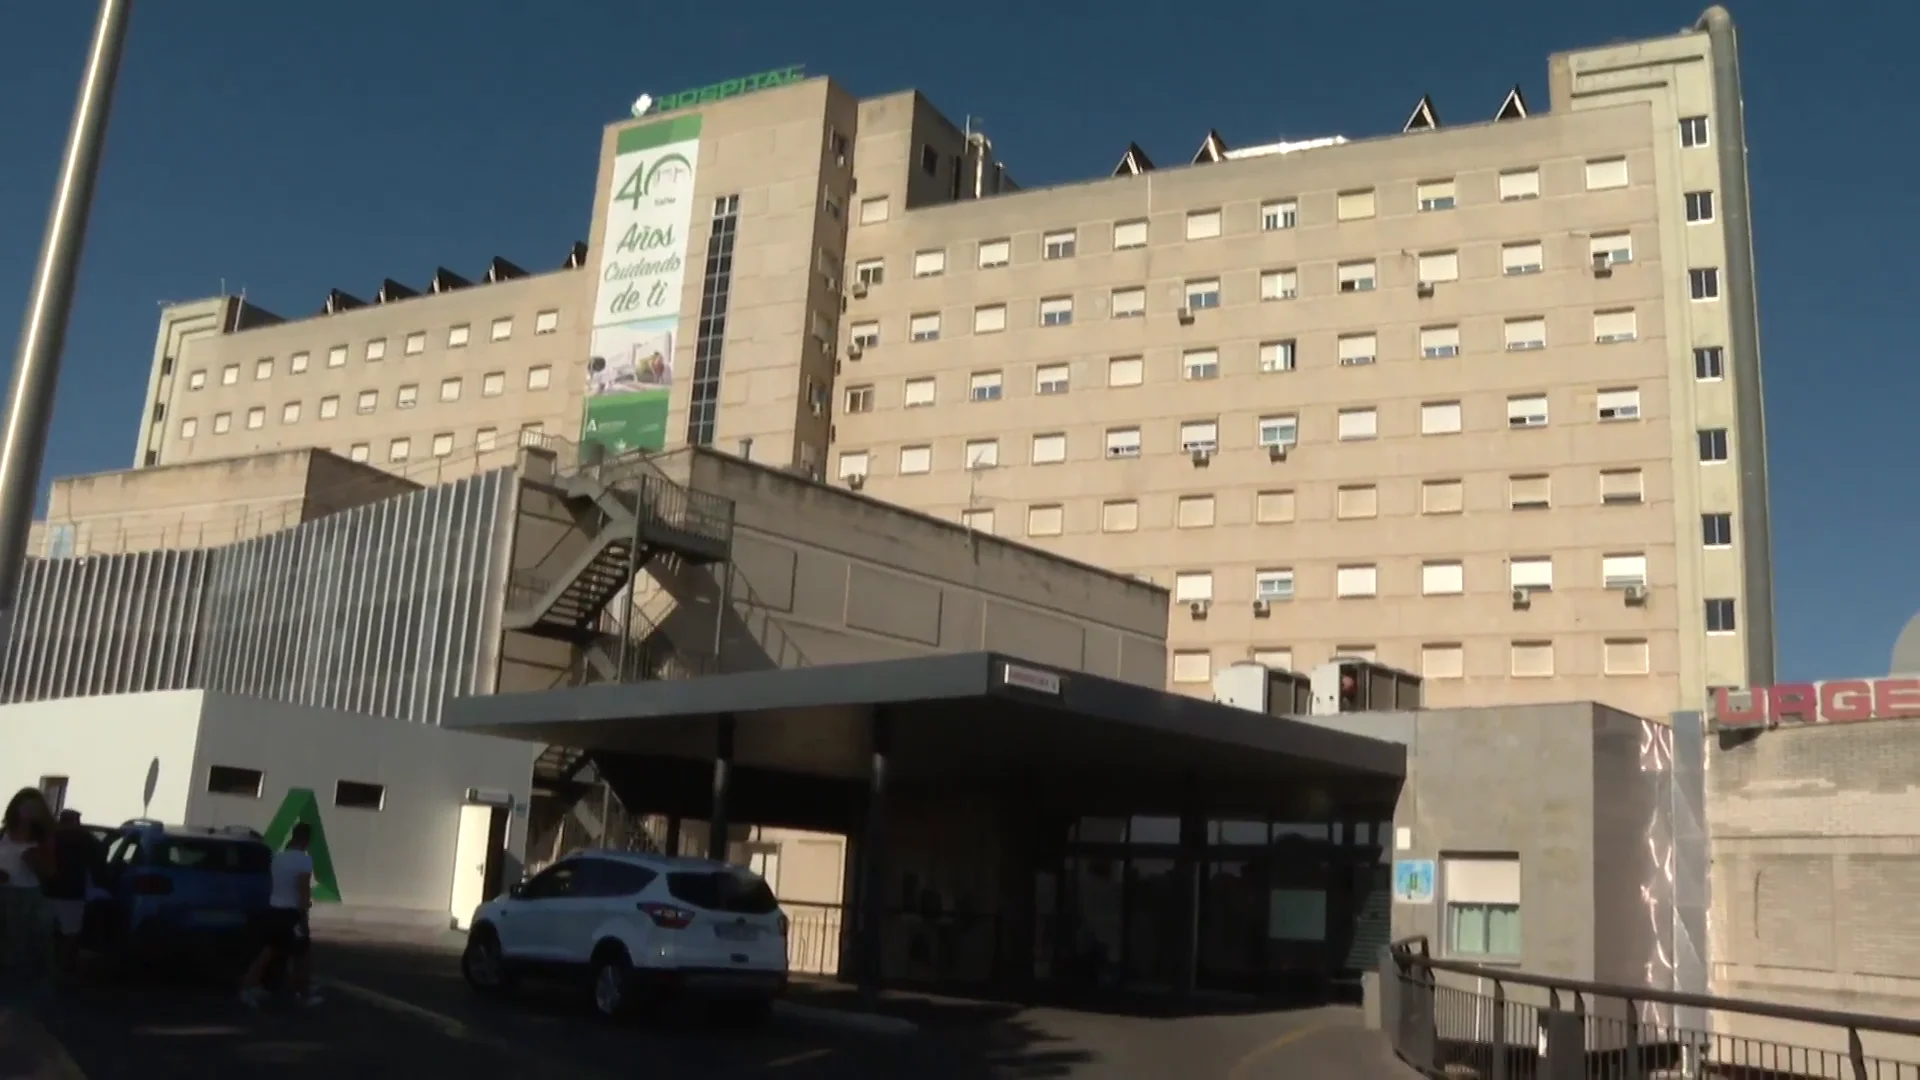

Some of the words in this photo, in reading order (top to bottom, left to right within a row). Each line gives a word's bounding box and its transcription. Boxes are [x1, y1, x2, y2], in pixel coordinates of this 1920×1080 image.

[658, 64, 805, 111] HOSPITAL
[616, 222, 674, 254] Años
[604, 252, 680, 282] Cuidando
[610, 281, 640, 313] de
[646, 280, 668, 308] ti
